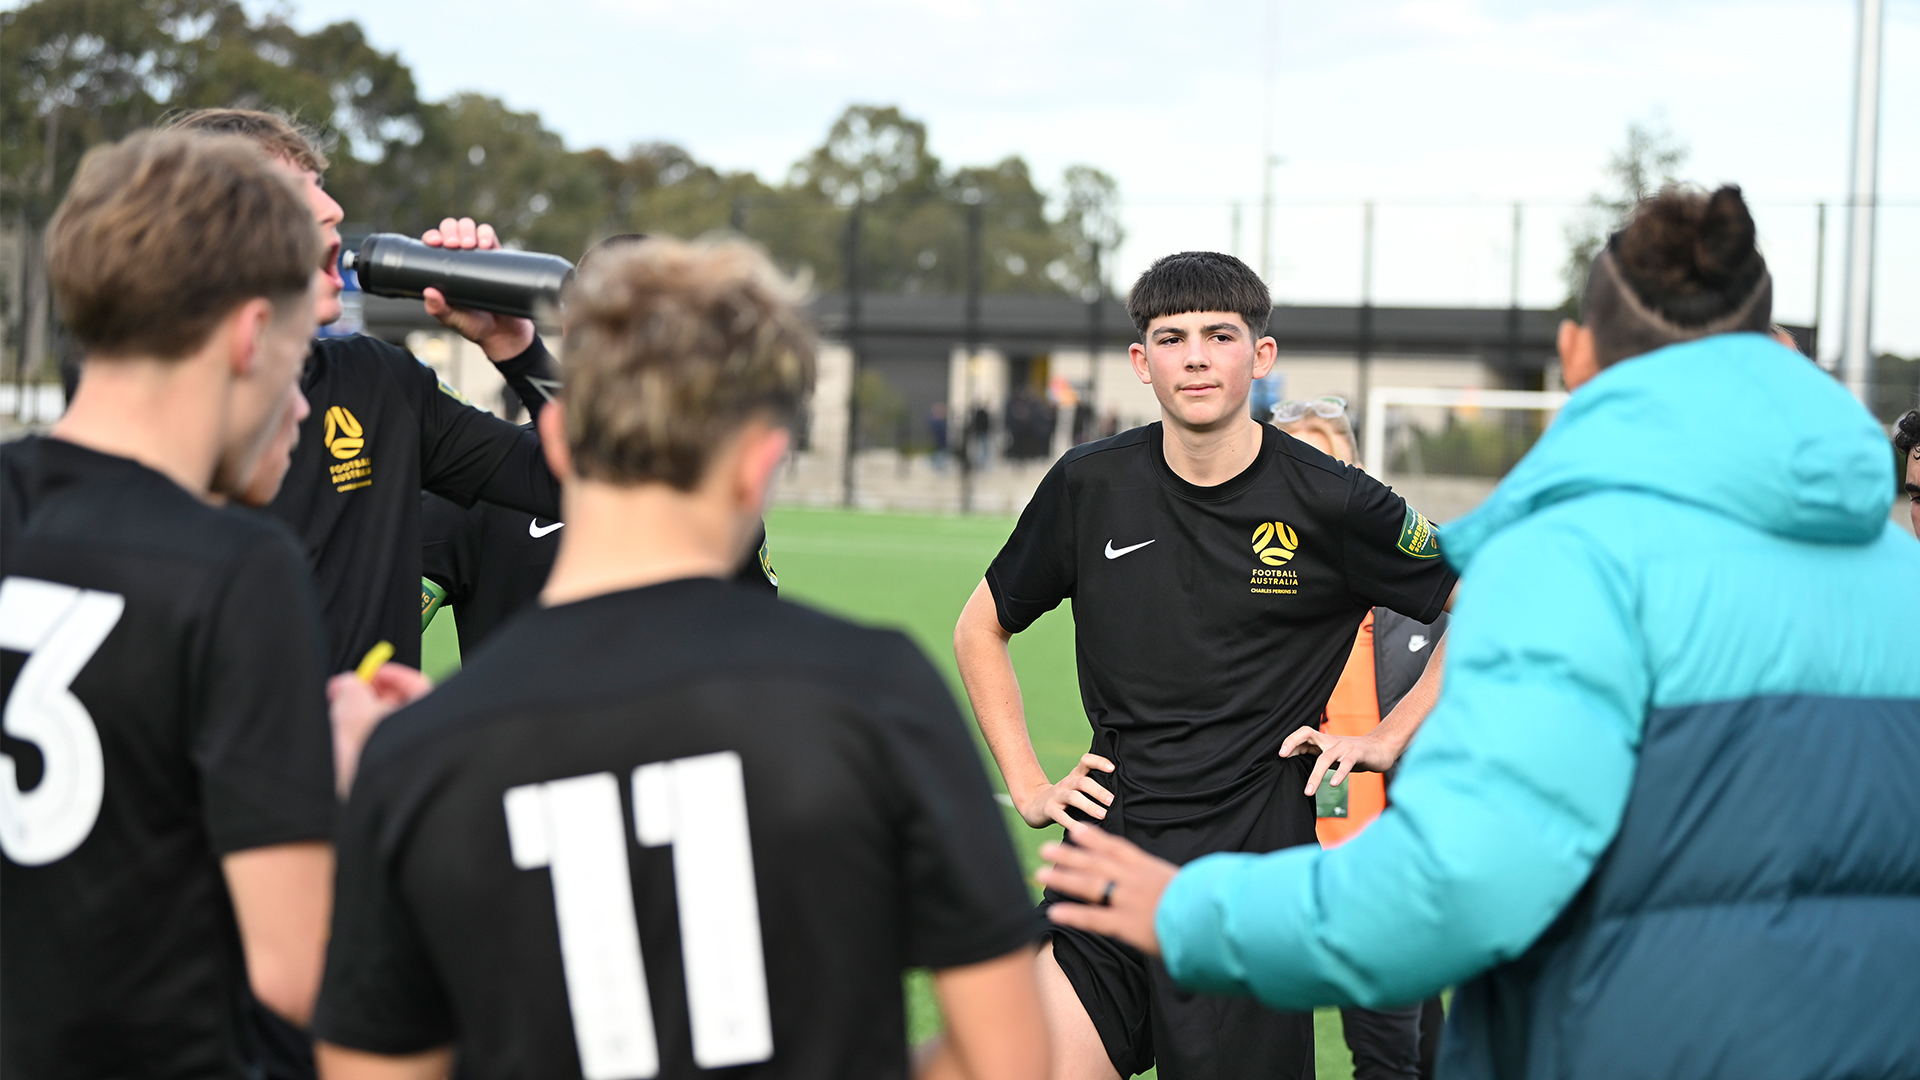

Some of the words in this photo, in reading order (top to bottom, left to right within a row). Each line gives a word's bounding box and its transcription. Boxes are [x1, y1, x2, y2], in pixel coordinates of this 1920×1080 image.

[1250, 577, 1298, 585] AUSTRALIA
[1252, 569, 1298, 577] FOOTBALL
[0, 575, 125, 866] 3
[503, 750, 775, 1080] 11
